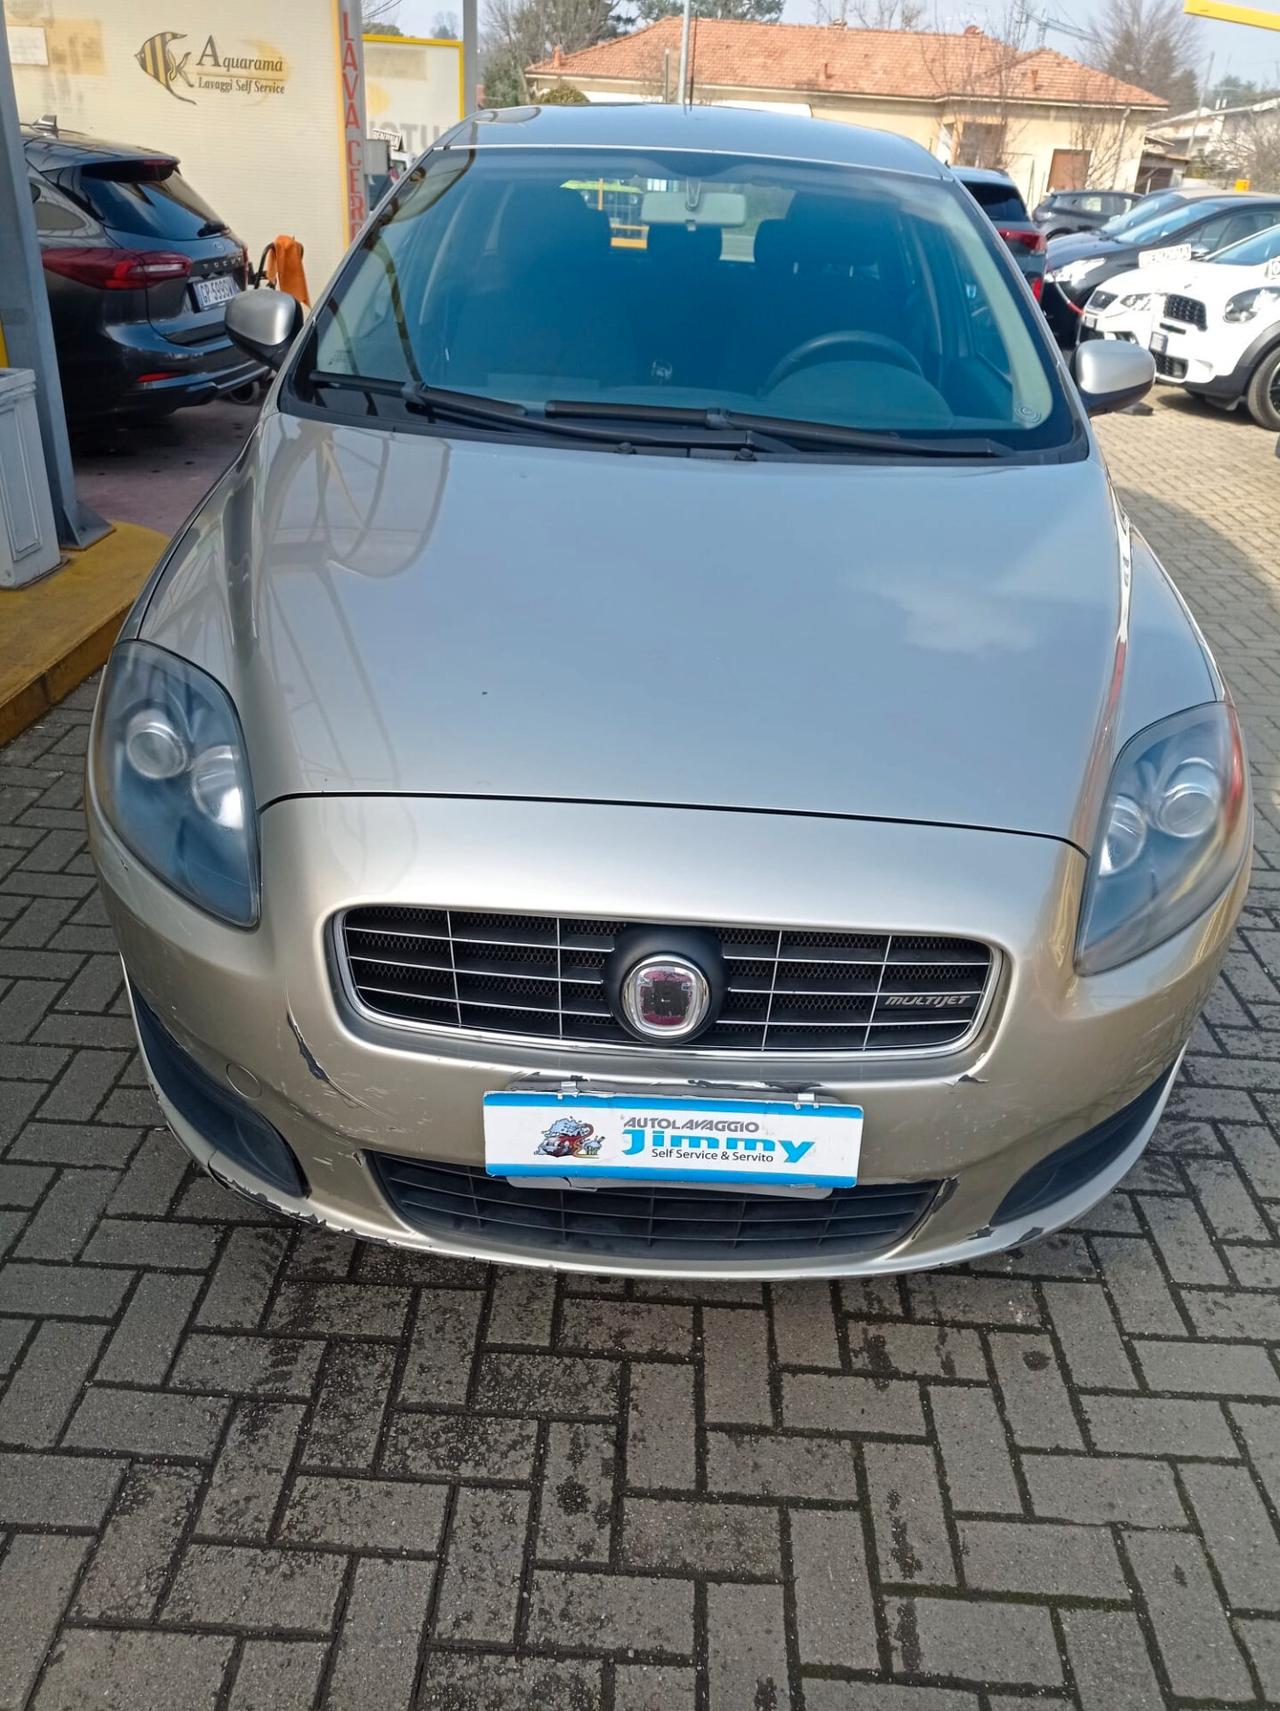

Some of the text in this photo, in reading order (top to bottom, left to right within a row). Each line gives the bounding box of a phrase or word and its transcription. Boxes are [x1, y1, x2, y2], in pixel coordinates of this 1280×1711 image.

[342, 11, 360, 129] LAVA
[198, 76, 285, 94] Lavaggi Self Service
[885, 995, 970, 1008] MULTIJET
[623, 1116, 760, 1133] AUTOLAVAGGIO
[621, 1128, 815, 1163] Jimmy
[651, 1148, 774, 1163] Self Service & Servito
